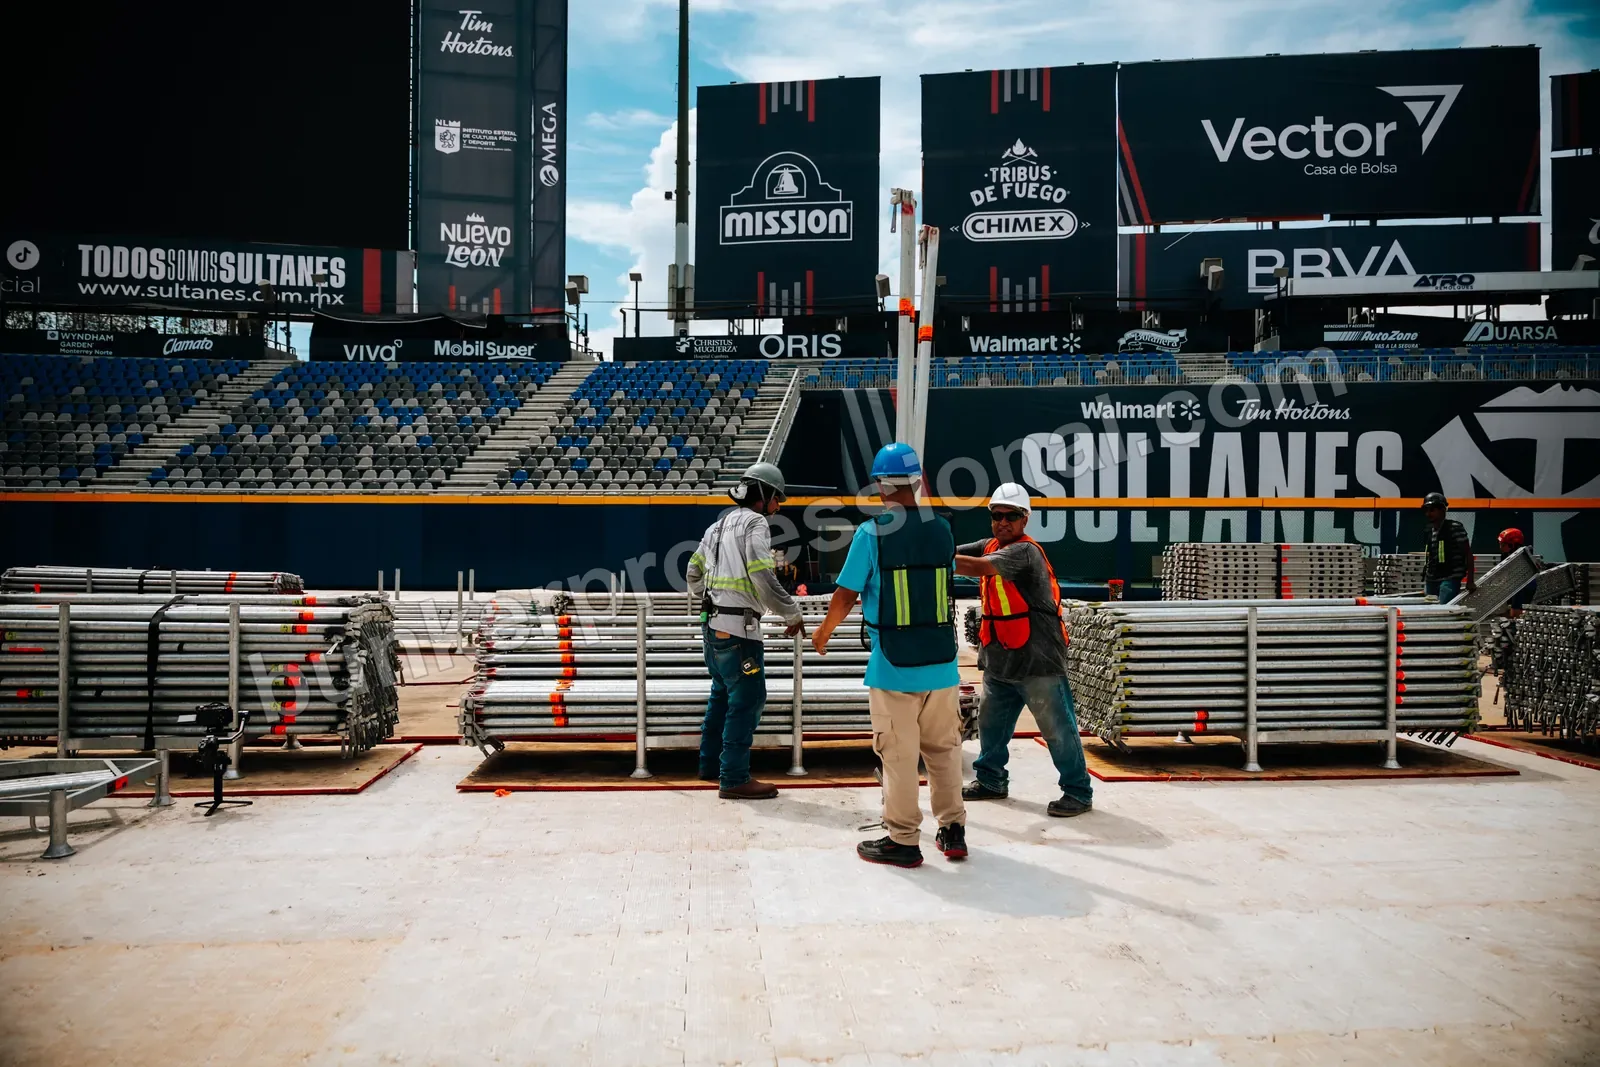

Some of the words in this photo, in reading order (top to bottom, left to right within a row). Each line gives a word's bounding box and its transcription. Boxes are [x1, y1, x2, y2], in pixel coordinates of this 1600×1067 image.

[459, 10, 493, 33] Tim
[440, 31, 513, 57] Hortons
[435, 118, 449, 127] NL
[1201, 115, 1397, 163] Vector
[989, 165, 1051, 183] TRIBUS
[1304, 163, 1336, 176] Casa
[1339, 162, 1358, 175] de
[1361, 161, 1397, 175] Bolsa
[969, 185, 998, 206] DE
[1002, 182, 1067, 204] FUEGO
[971, 216, 1065, 234] CHIMEX
[1247, 238, 1418, 294] BBVA
[1413, 273, 1475, 288] ATRO
[77, 282, 345, 306] www.sultanes.cm.mx
[59, 341, 93, 349] GARDEN
[60, 332, 114, 342] WYNDHAM
[969, 334, 1058, 353] Walmart
[1360, 330, 1419, 342] AutoZone
[59, 348, 93, 356] Monterrey
[162, 336, 214, 356] Clamato
[759, 333, 842, 359] ORIS
[1080, 401, 1176, 419] Walmart
[1236, 398, 1272, 420] Tim
[1275, 397, 1350, 420] Hortons
[1021, 430, 1404, 544] SULTANES
